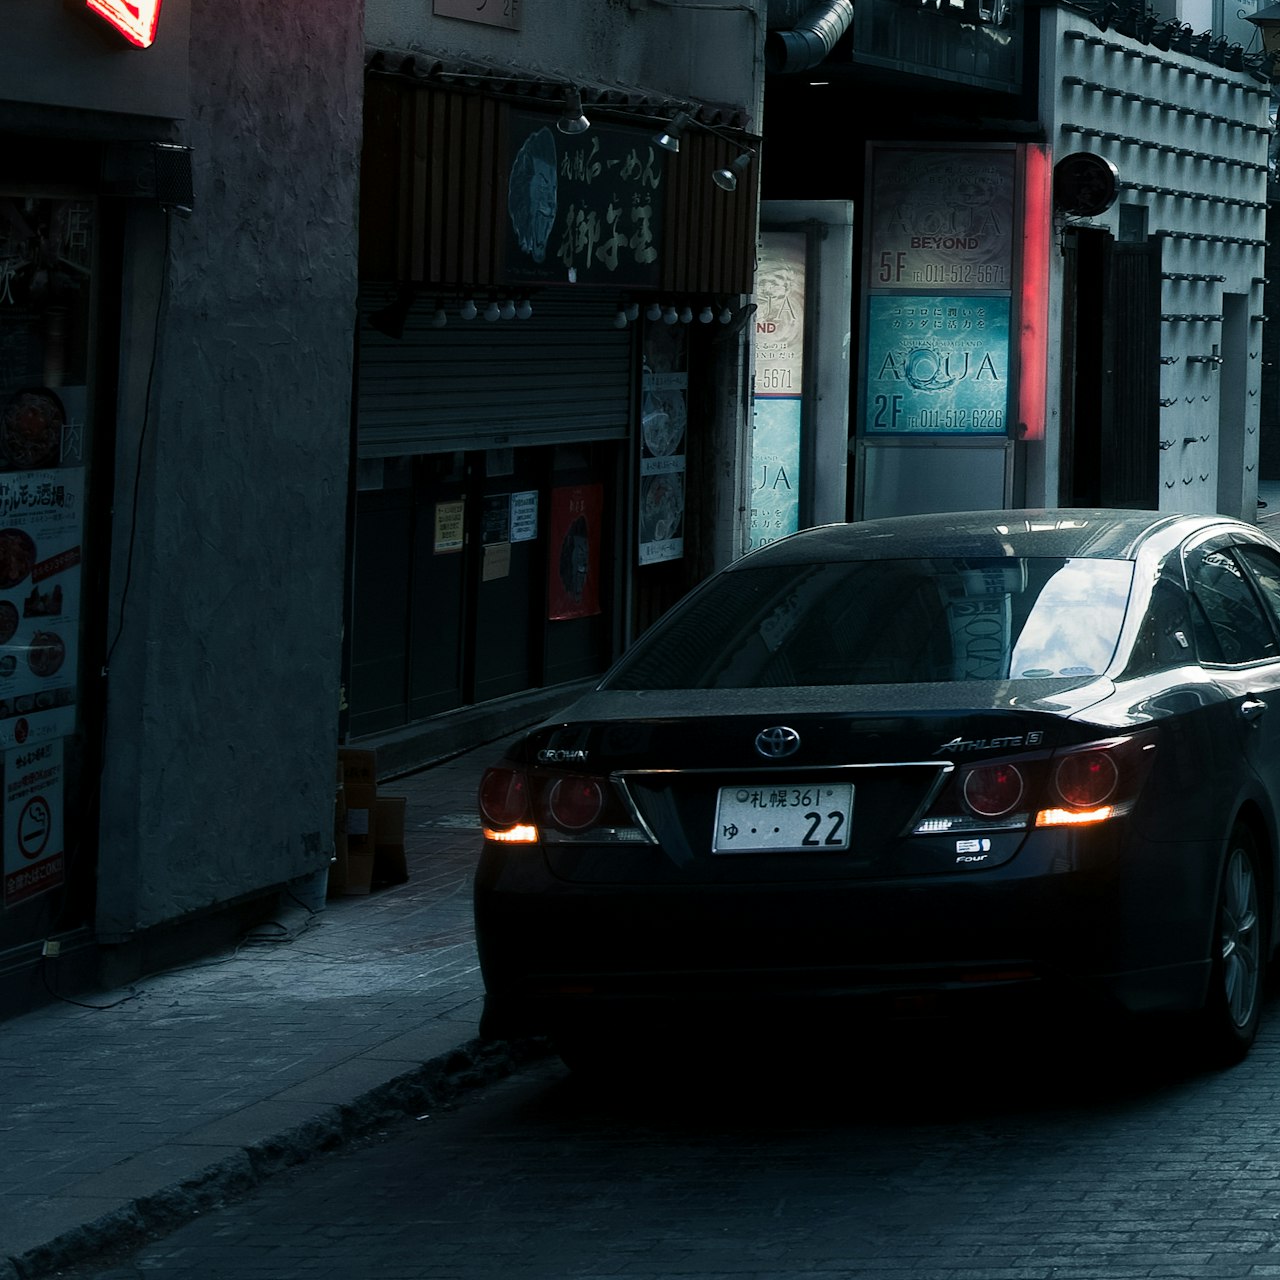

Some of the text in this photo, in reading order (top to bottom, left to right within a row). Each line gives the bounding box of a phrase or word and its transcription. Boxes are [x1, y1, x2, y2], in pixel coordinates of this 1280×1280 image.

[910, 236, 980, 251] BEYOND
[879, 251, 907, 283] 5F
[925, 264, 1005, 284] 011-512-5671
[893, 306, 986, 318] ココロに潤いを
[891, 318, 986, 330] カラダに活力を
[877, 347, 1000, 392] AQUA
[873, 394, 904, 429] 2F
[920, 408, 1003, 429] 011-512-6226
[932, 735, 1025, 757] ATHLETE
[536, 747, 591, 766] CROWN
[751, 787, 822, 809] 札幌 361
[721, 822, 739, 842] ゆ
[954, 852, 990, 865] Four
